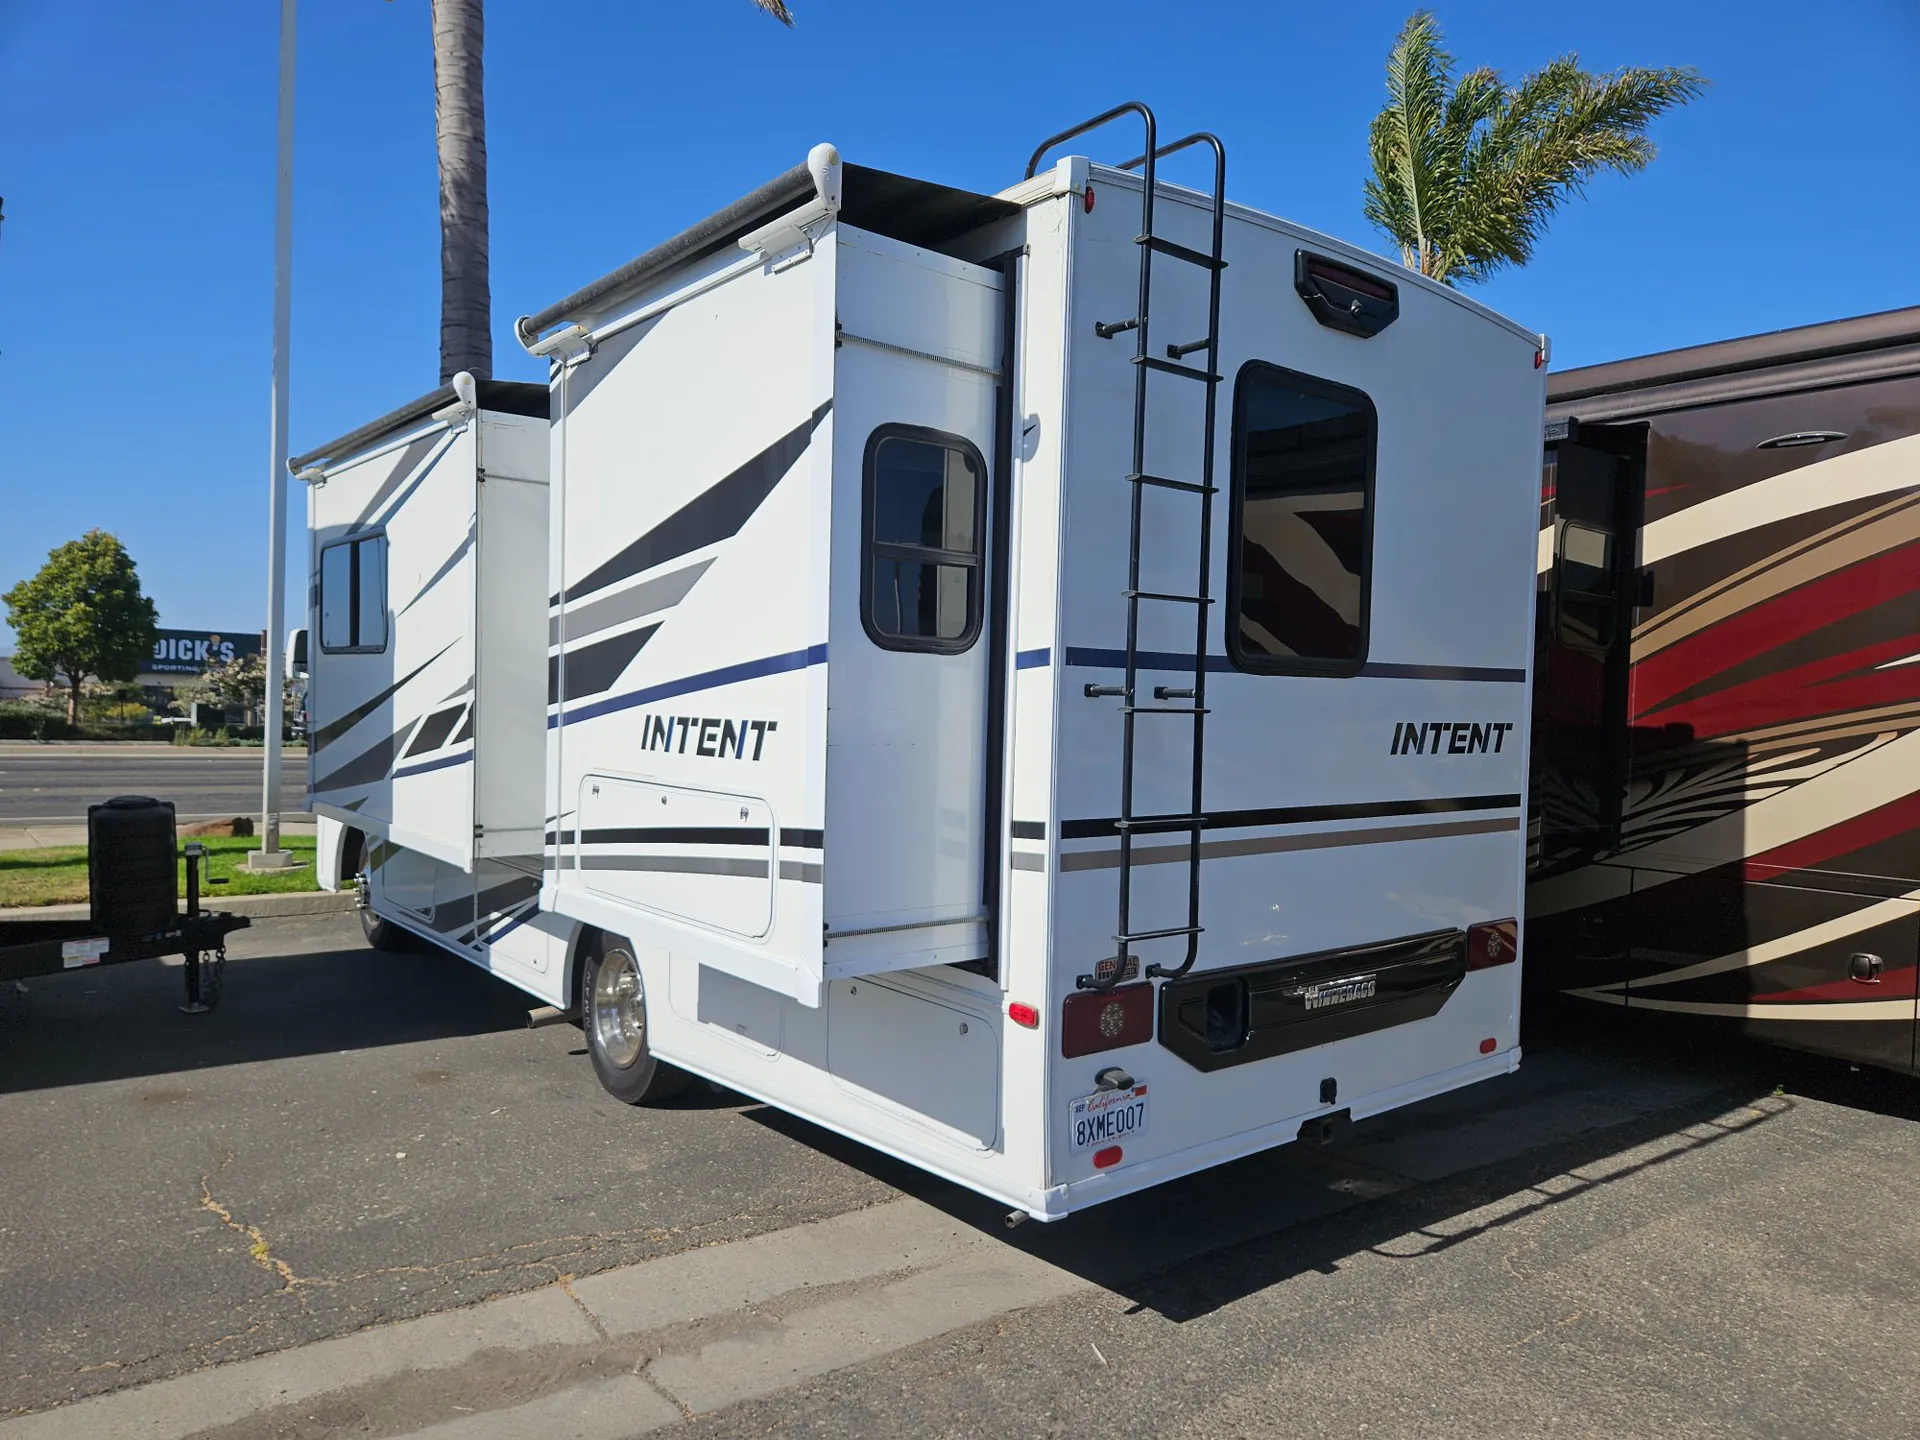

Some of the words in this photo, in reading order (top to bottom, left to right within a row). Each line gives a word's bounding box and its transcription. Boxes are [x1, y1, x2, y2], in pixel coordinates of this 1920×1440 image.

[153, 638, 235, 662] DICK'S
[640, 714, 778, 762] INTENT
[1390, 722, 1513, 755] INTENT
[1098, 956, 1138, 971] GENAL
[1087, 1093, 1132, 1113] California
[1076, 1102, 1144, 1146] 8XME007
